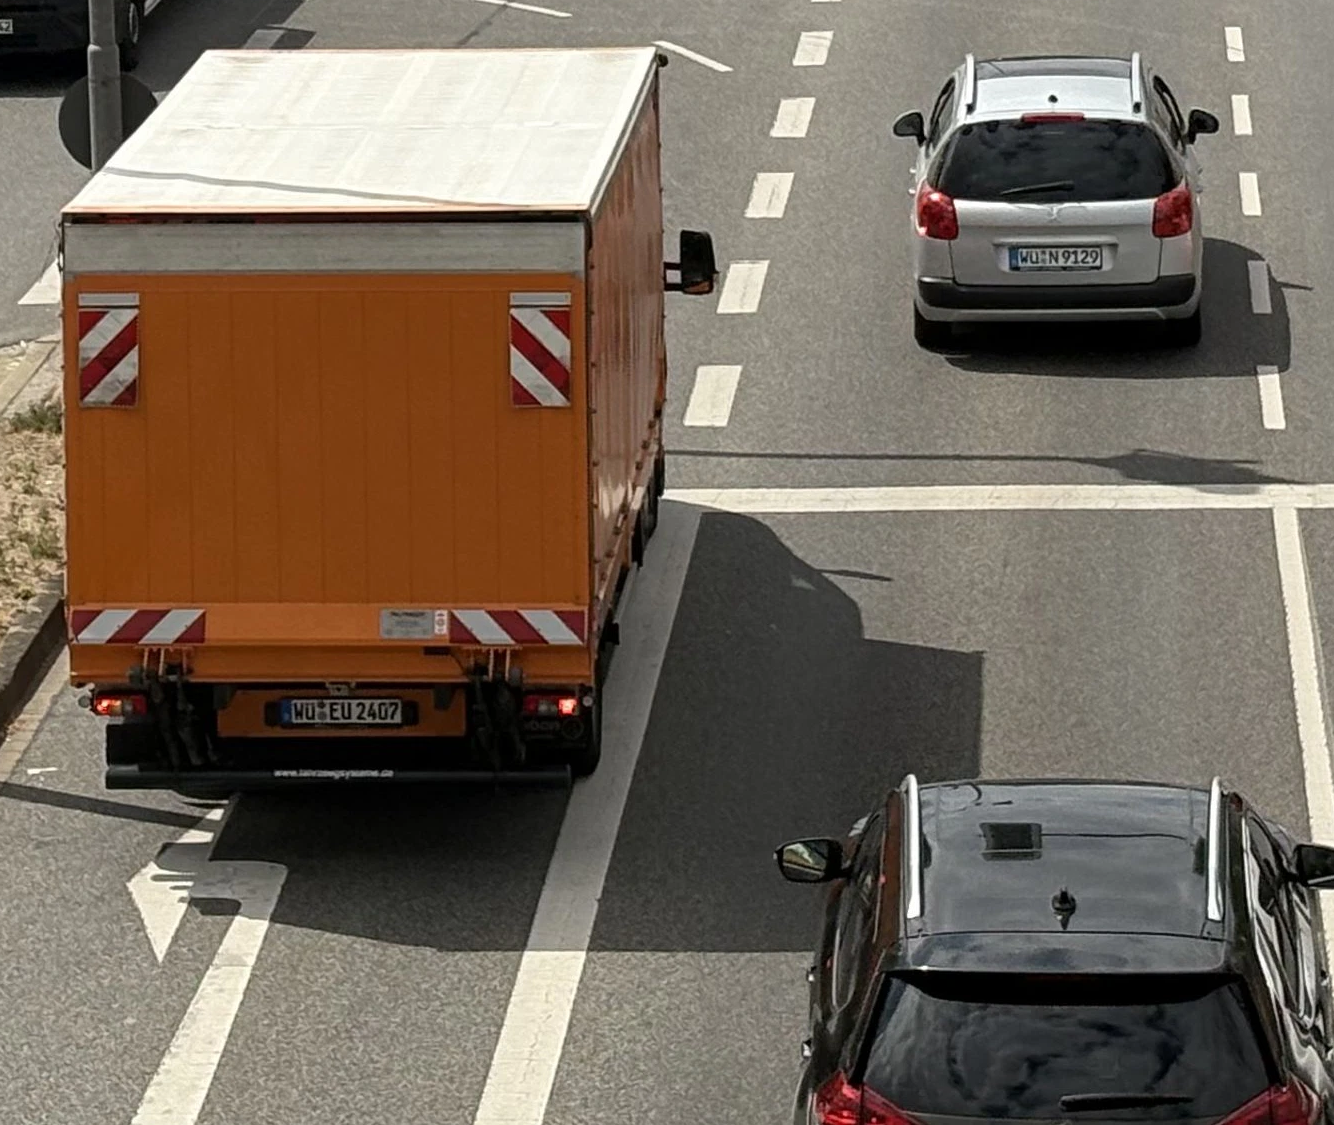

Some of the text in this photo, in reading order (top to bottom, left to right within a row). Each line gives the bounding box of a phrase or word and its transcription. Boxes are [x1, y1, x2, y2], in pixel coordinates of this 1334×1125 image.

[1049, 250, 1059, 264] N
[1062, 250, 1099, 264] 9129
[329, 702, 352, 721] EU
[356, 702, 398, 721] 2407
